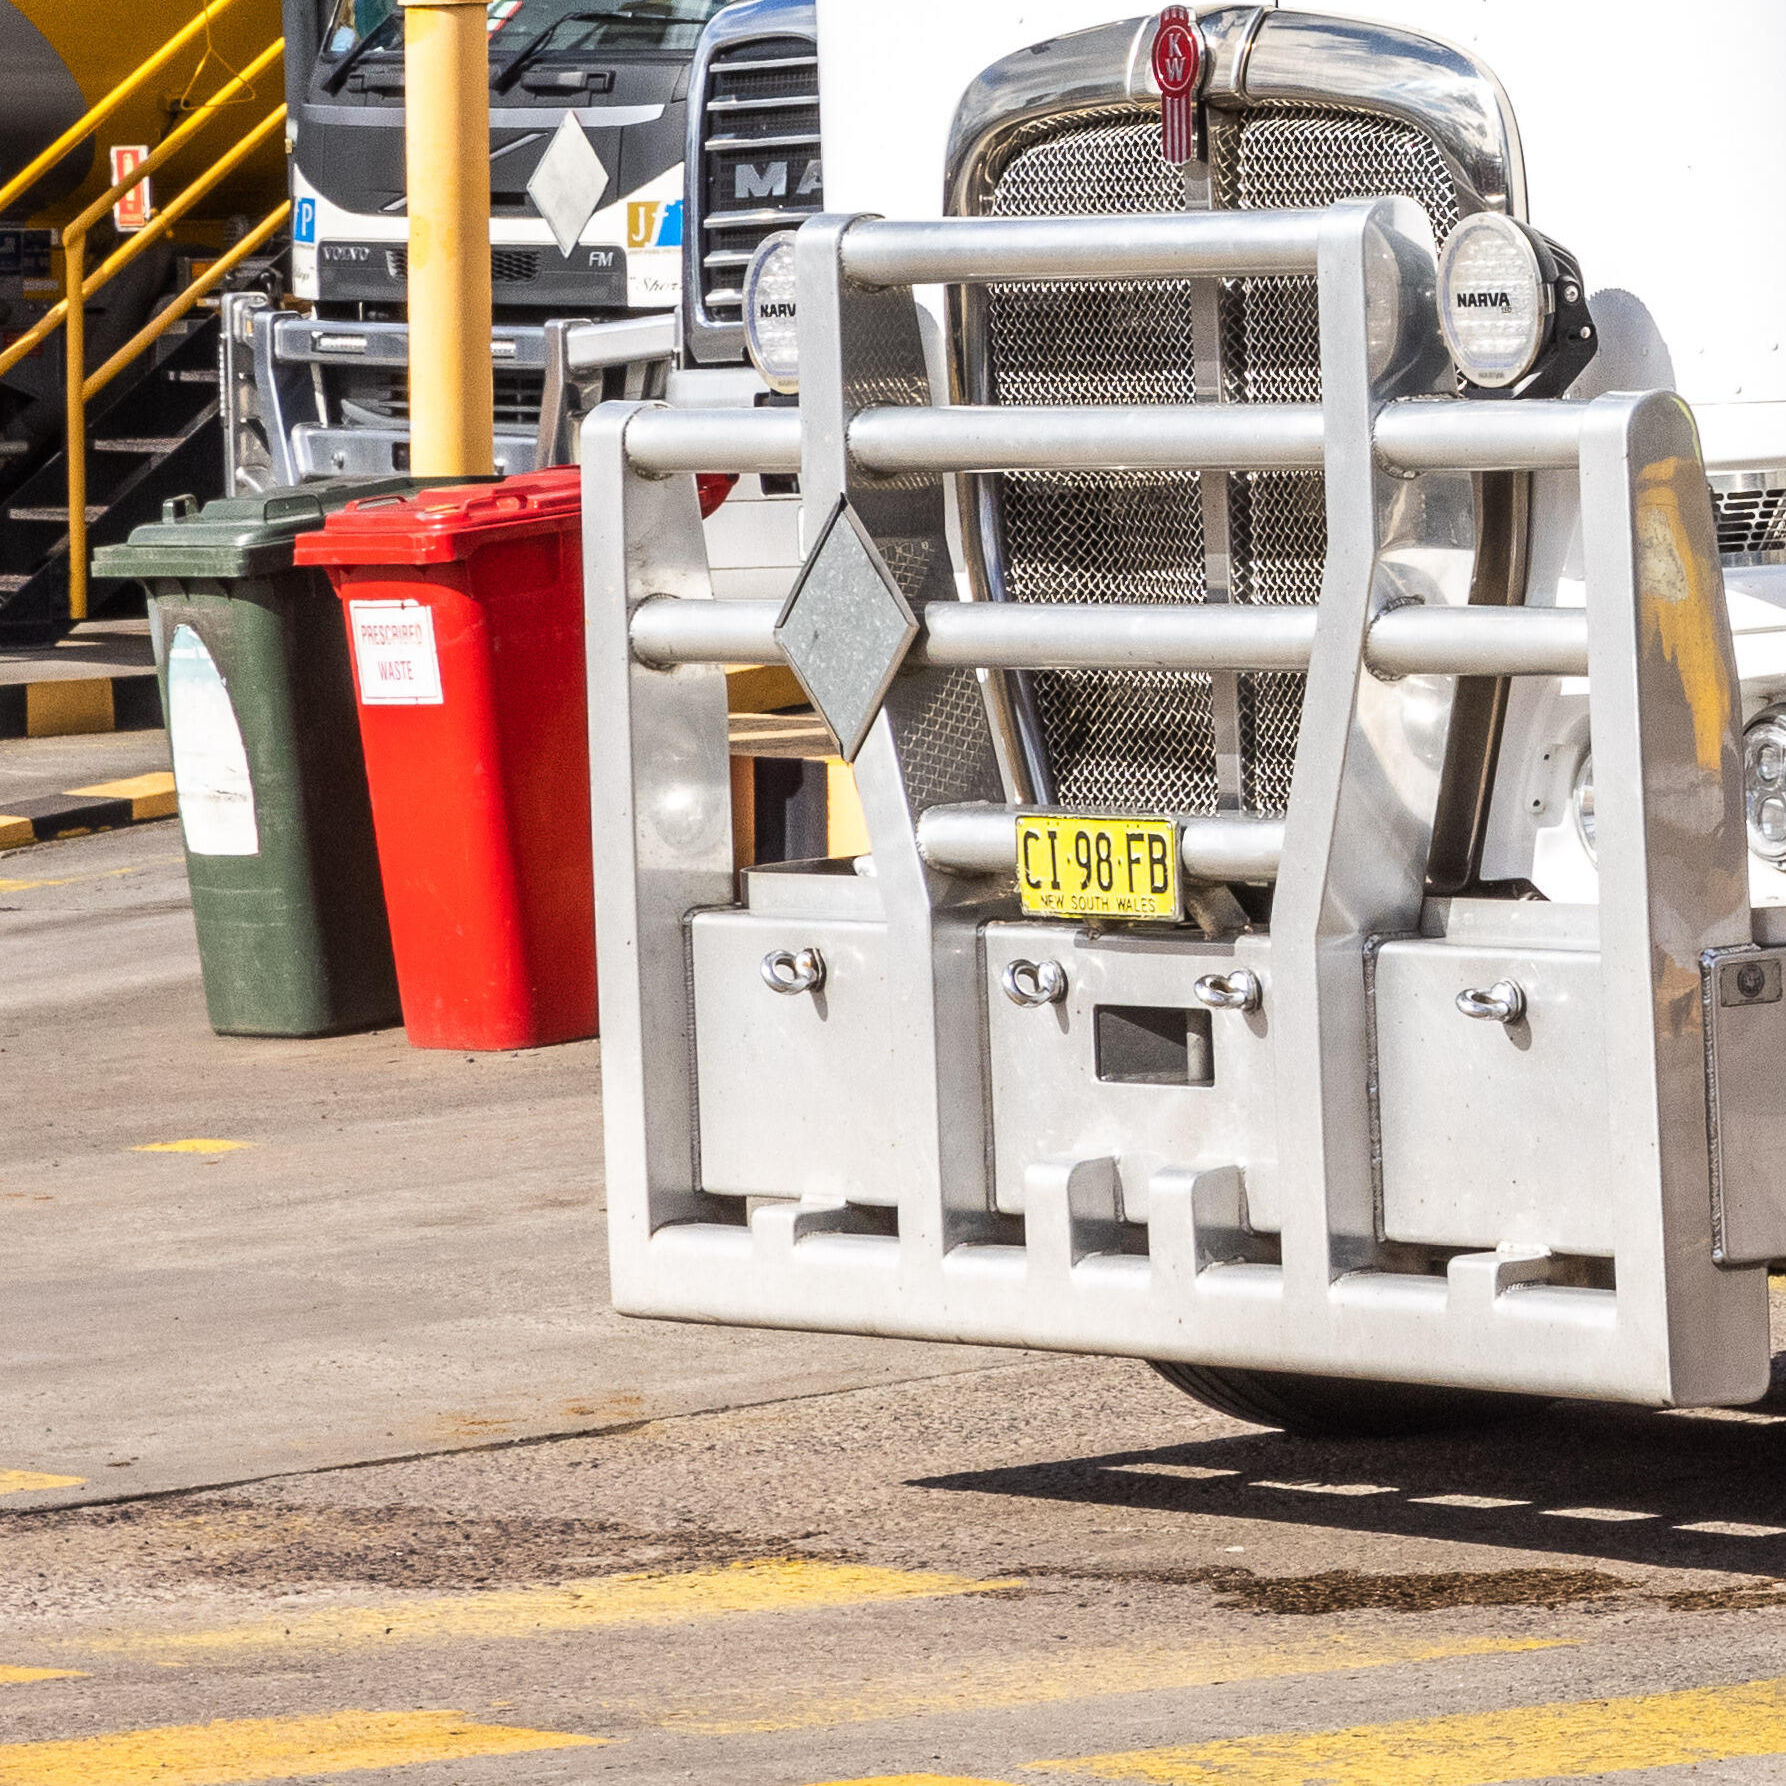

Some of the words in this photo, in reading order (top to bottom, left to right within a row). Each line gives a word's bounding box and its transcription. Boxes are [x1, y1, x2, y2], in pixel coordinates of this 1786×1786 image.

[324, 246, 369, 262] VOLVO
[589, 252, 613, 267] FM
[1457, 292, 1510, 308] NARVA
[760, 303, 797, 318] NARV
[378, 660, 414, 681] WASTE
[1041, 895, 1065, 910] NEW
[1071, 895, 1109, 911] SOUTH
[1117, 898, 1156, 913] WALES
